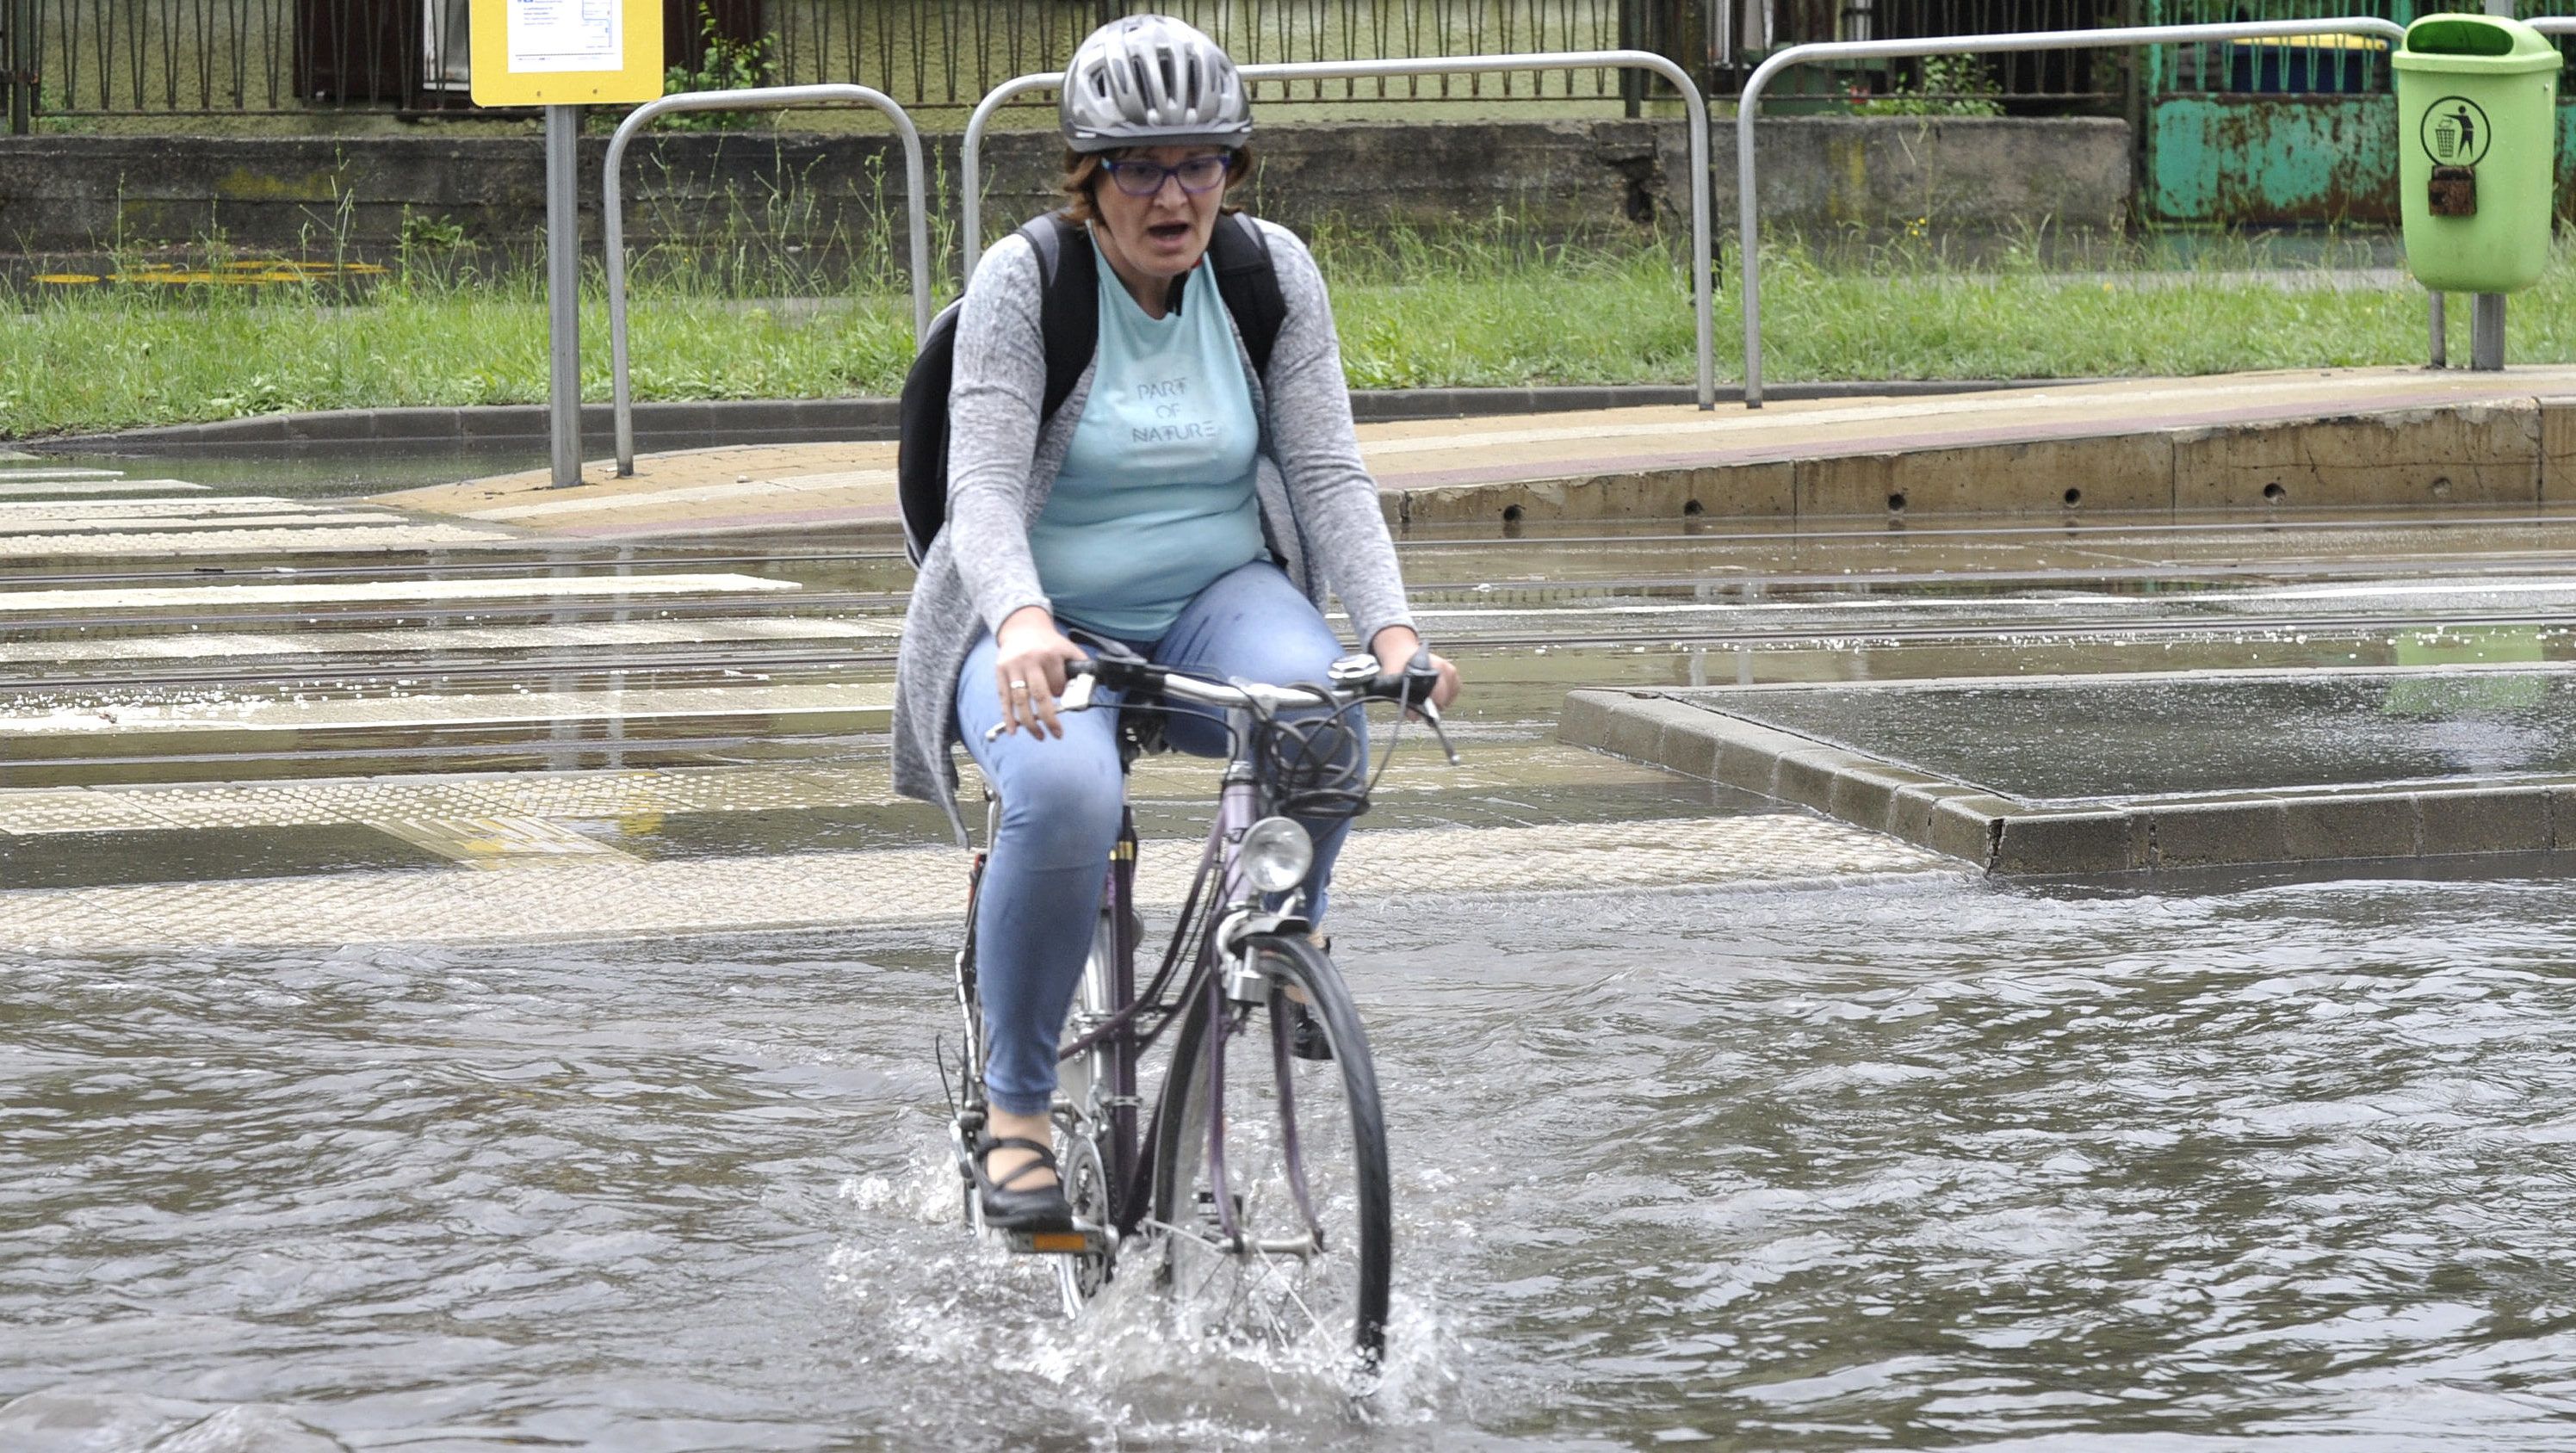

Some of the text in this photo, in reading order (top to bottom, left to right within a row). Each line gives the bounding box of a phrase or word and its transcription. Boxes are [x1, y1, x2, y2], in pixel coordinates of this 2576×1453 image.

[1136, 377, 1187, 399] PART
[1155, 403, 1183, 419] OF
[1132, 420, 1217, 443] NATURE
